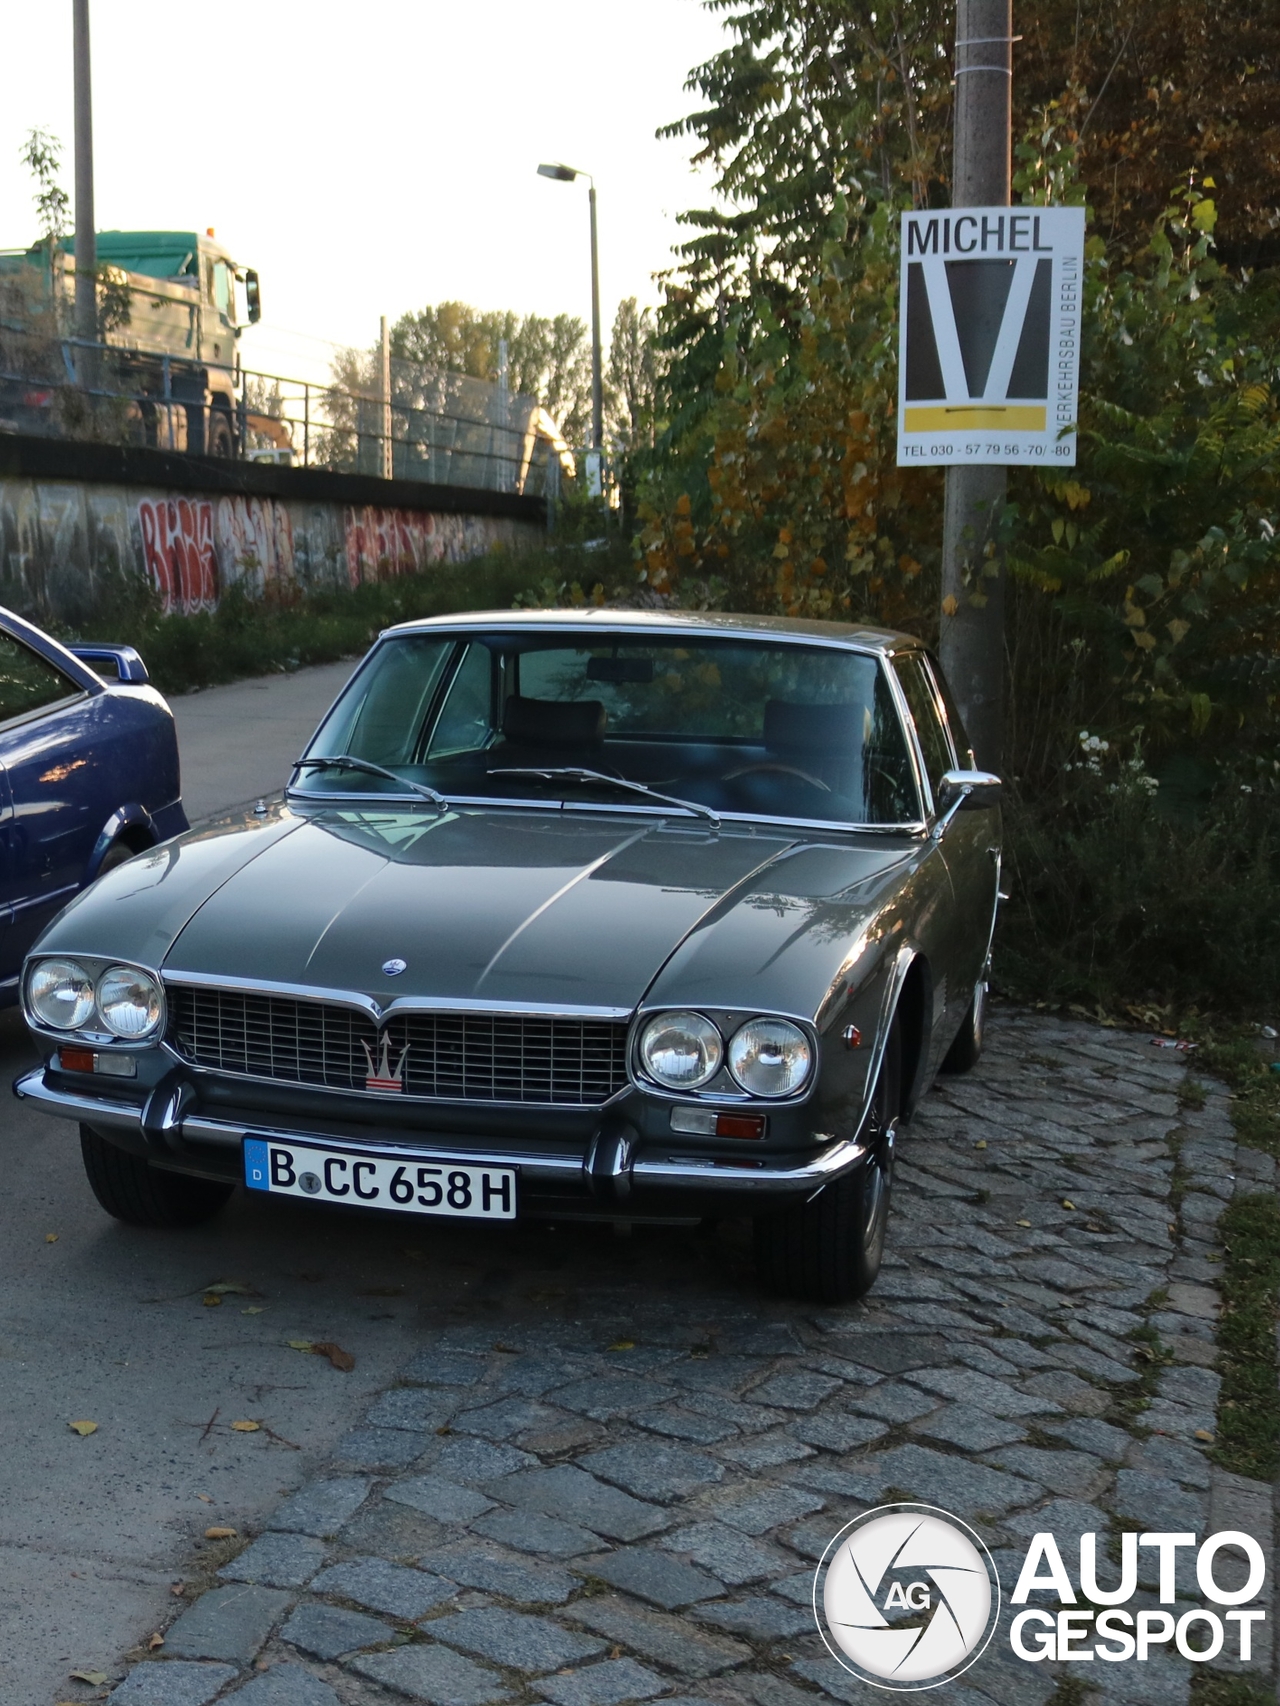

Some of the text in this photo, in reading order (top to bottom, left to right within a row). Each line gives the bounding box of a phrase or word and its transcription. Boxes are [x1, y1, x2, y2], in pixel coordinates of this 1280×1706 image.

[908, 215, 1053, 256] MICHEL
[1061, 256, 1078, 312] BERLIN
[904, 446, 927, 457] TEL
[931, 445, 954, 456] 030
[966, 444, 981, 455] 57
[985, 444, 1001, 455] 79
[1004, 445, 1020, 456] 56
[252, 1169, 262, 1182] D
[270, 1148, 297, 1188] B
[324, 1157, 380, 1200] CC
